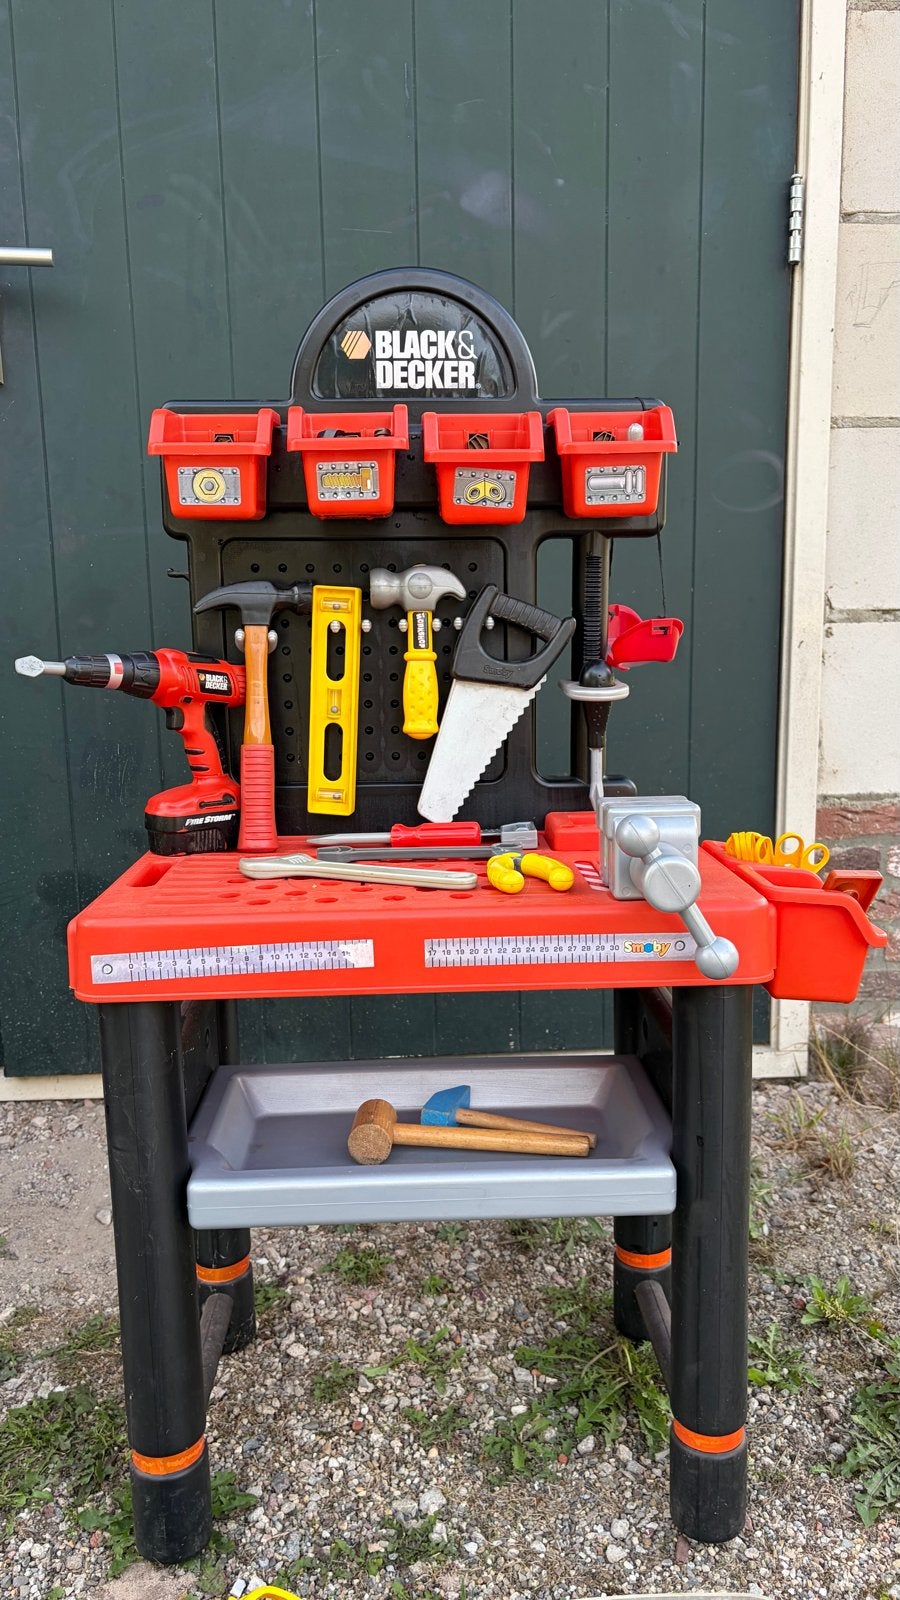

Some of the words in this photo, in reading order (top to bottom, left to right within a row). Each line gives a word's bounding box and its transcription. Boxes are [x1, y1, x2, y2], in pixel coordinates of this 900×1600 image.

[375, 330, 478, 359] BLACK&
[205, 682, 228, 690] DECKER
[185, 818, 204, 826] FIRE
[624, 940, 670, 958] Smoby
